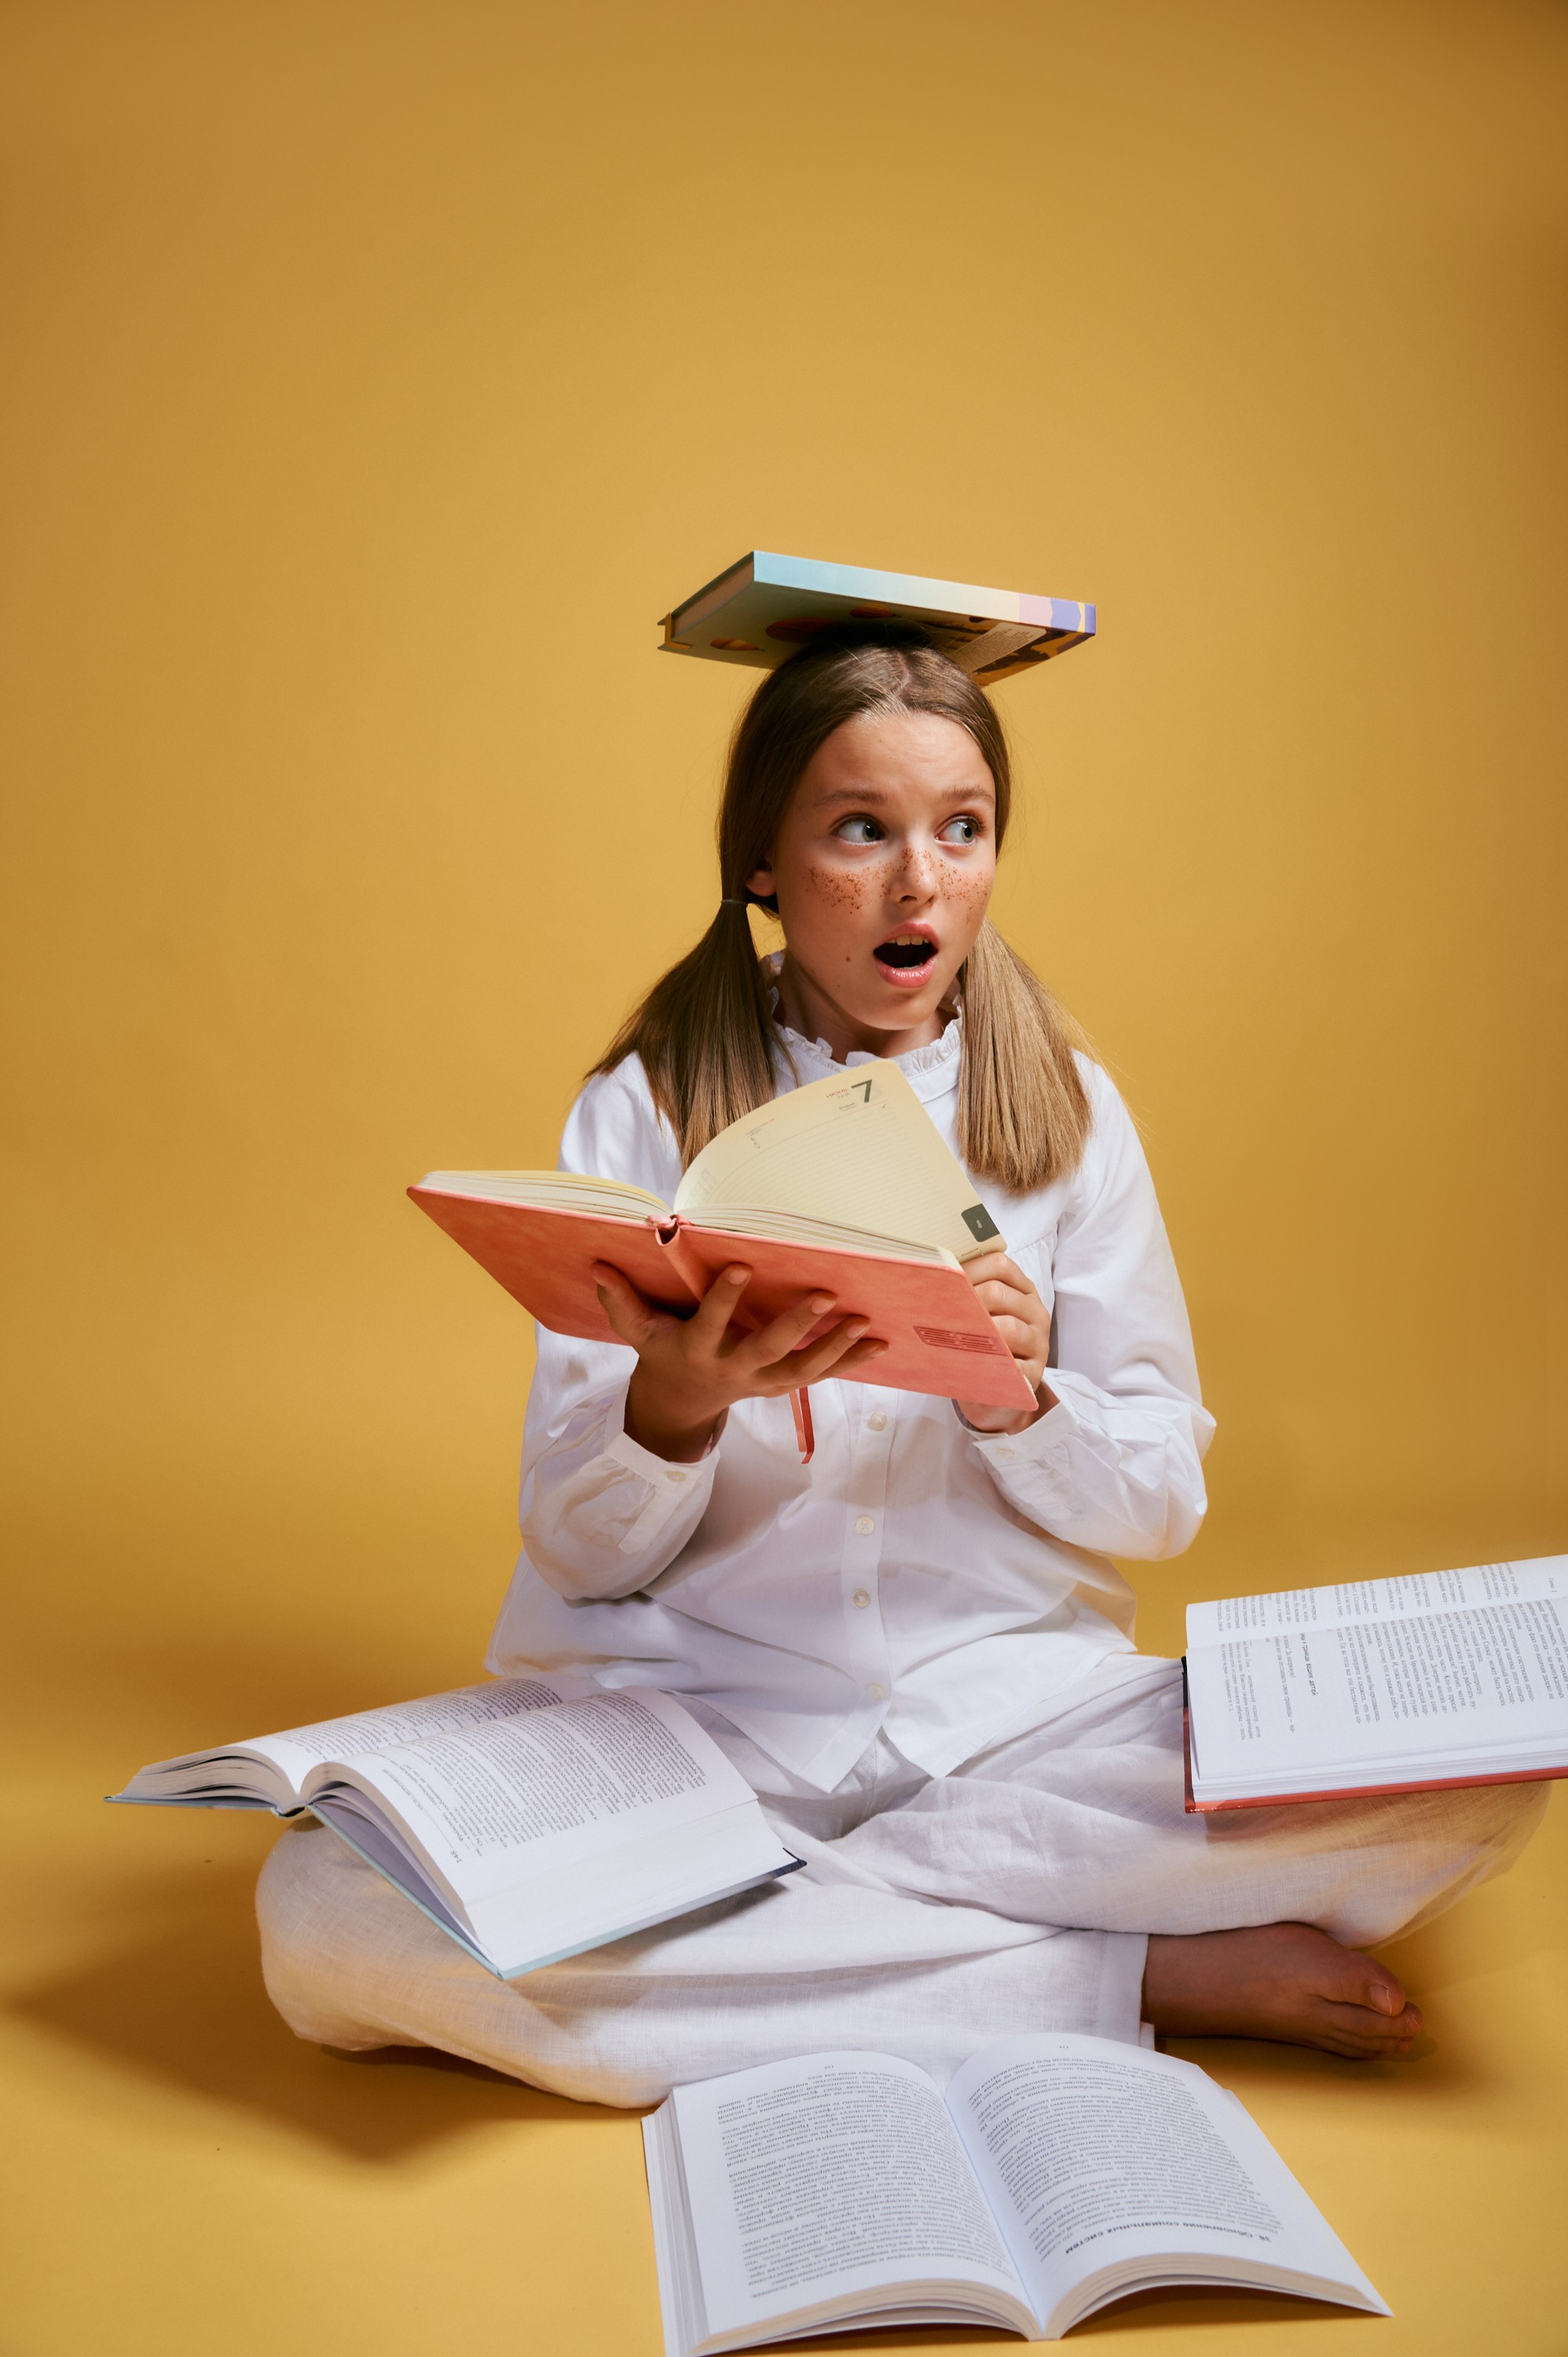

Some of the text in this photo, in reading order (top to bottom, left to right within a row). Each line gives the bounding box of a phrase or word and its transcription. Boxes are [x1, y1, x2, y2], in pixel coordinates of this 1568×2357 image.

[851, 1079, 872, 1103] 7
[1107, 2222, 1179, 2234] социальных
[1182, 2222, 1252, 2238] Обновление
[1065, 2231, 1103, 2255] систем
